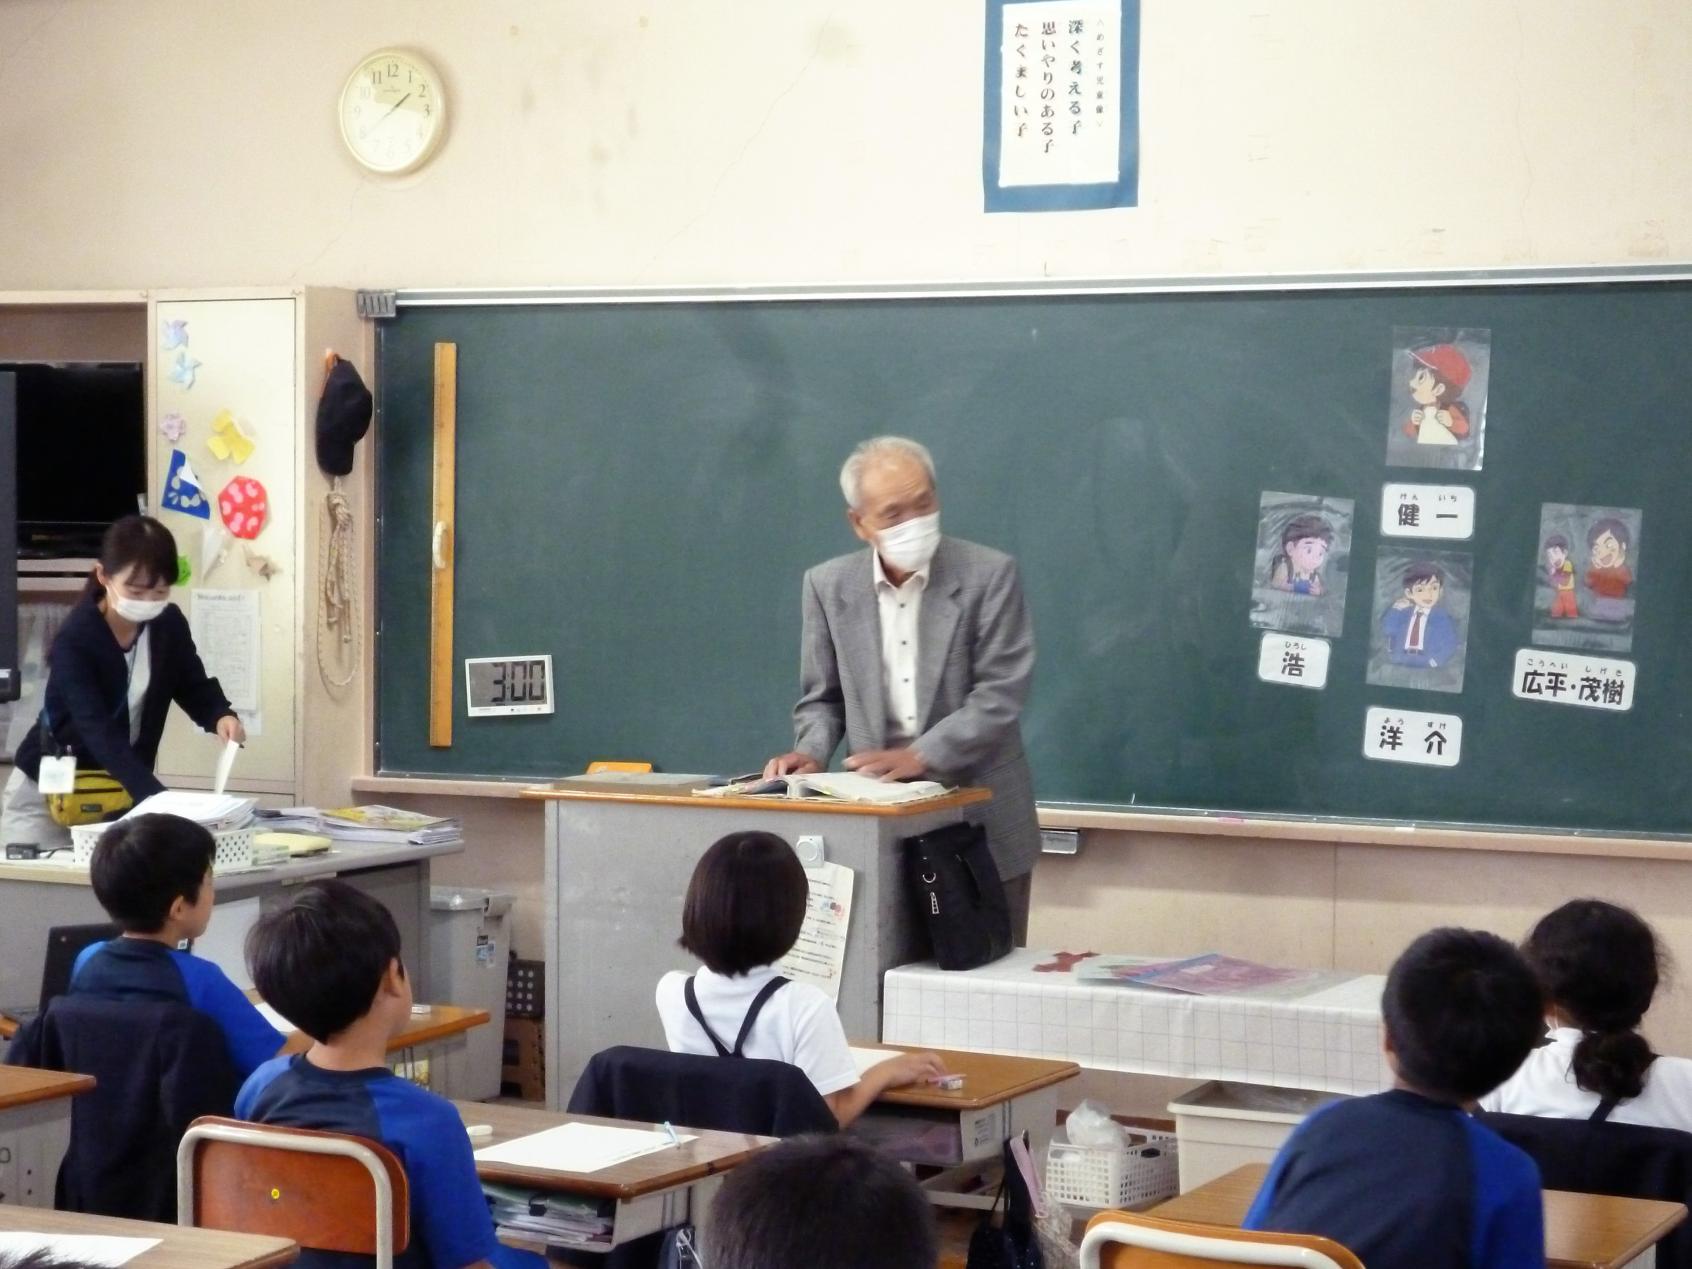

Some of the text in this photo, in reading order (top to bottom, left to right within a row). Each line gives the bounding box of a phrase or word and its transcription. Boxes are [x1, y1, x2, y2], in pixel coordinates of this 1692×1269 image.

[372, 71, 382, 84] 11
[387, 64, 399, 77] 12
[1014, 23, 1028, 137] たくましい子
[1068, 19, 1084, 135] 深く考える子
[418, 84, 426, 98] 2
[1041, 21, 1056, 153] 思いやりのある子
[424, 104, 431, 118] 3
[1398, 503, 1458, 527] 健一
[1285, 641, 1307, 650] ひろし
[1281, 651, 1305, 677] 浩
[1521, 669, 1625, 705] 広平・茂樹
[1379, 725, 1447, 755] 洋介
